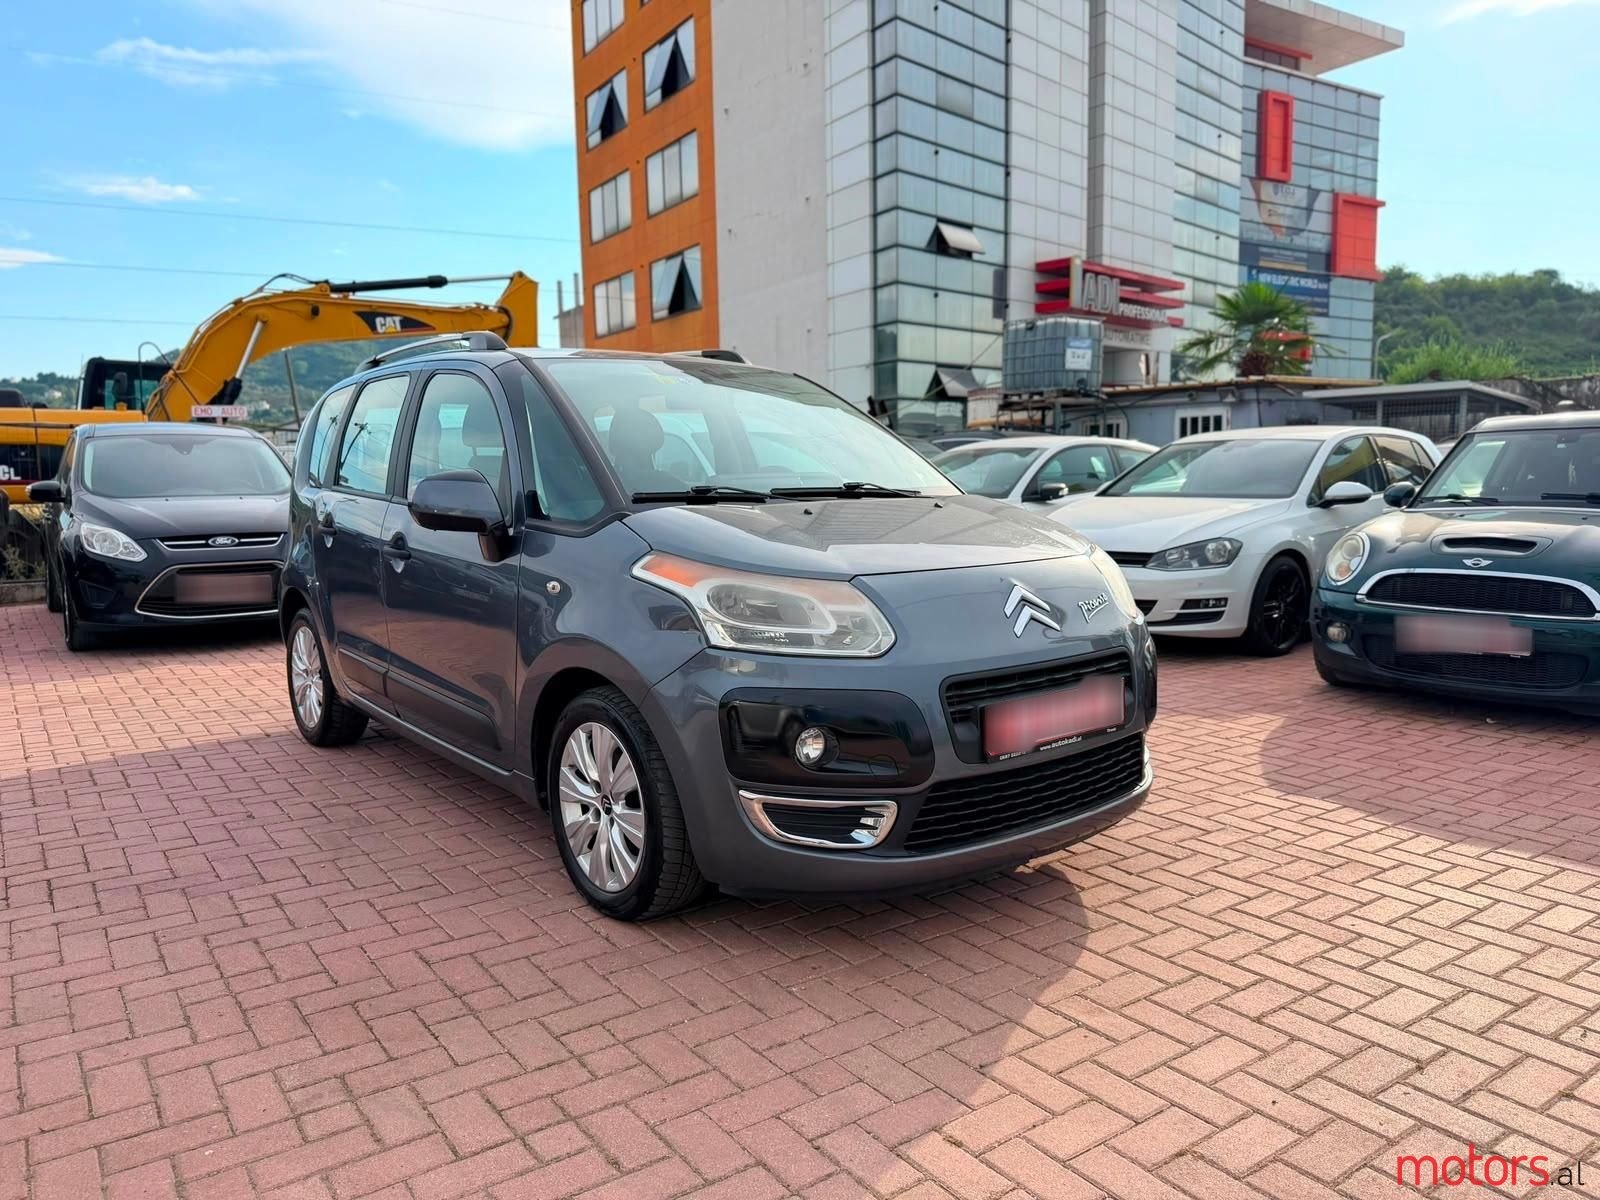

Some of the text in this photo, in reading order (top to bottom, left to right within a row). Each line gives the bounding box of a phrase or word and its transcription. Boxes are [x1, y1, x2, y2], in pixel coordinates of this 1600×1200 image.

[1083, 272, 1120, 315] ADI
[1119, 302, 1168, 323] PROFESSIONAL
[375, 316, 403, 333] CAT
[194, 406, 246, 417] EMO AUTO
[1040, 735, 1082, 751] www.autokadi.al
